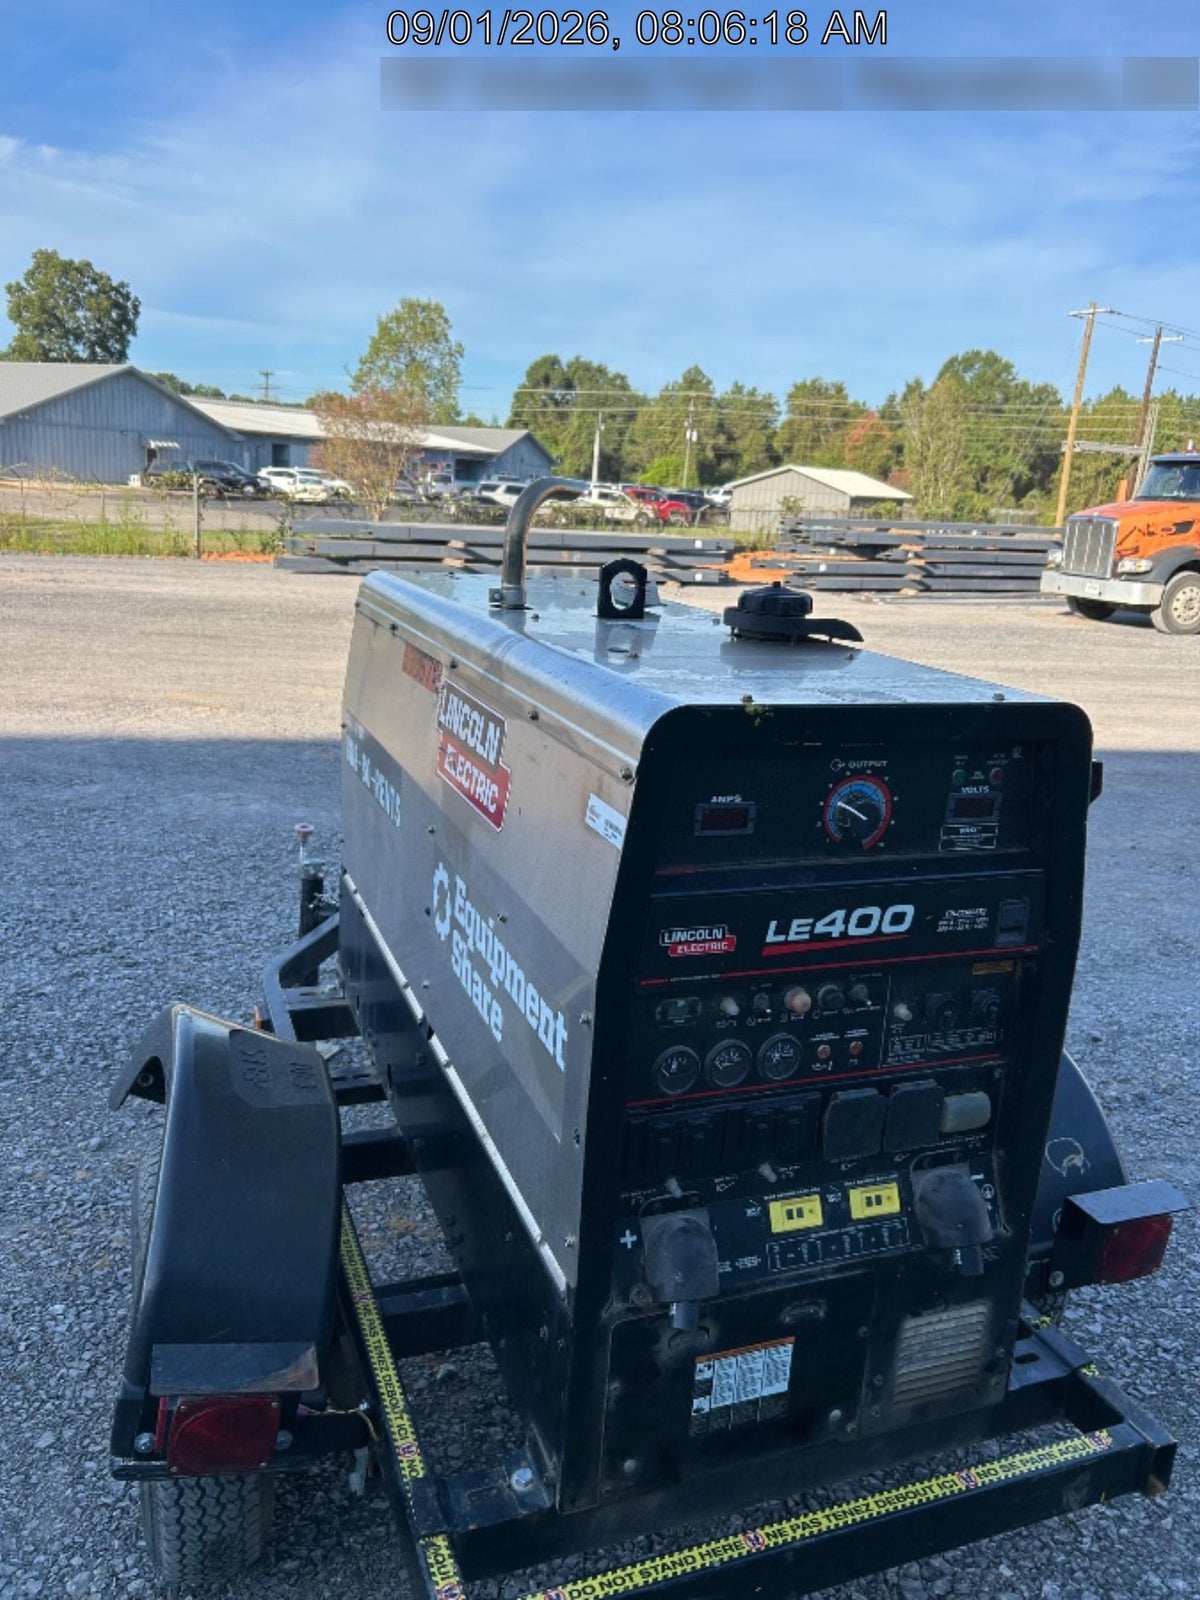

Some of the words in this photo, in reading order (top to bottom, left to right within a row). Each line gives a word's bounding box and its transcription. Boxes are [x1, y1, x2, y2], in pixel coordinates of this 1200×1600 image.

[439, 688, 500, 765] LINCOLN
[444, 743, 499, 814] ELECTRIC
[848, 760, 888, 769] OUTPUT
[961, 785, 989, 794] VOLTS
[664, 927, 723, 943] LINCOLN
[677, 941, 728, 954] ELECTRIC
[765, 904, 915, 943] LE400
[451, 929, 503, 1043] Share
[454, 874, 568, 1072] Equipment
[382, 1374, 404, 1421] DEBOUT
[396, 1424, 409, 1440] ICI
[568, 1585, 596, 1600] DO
[600, 1572, 637, 1591] NOT
[639, 1554, 696, 1579] STAND
[698, 1540, 746, 1562] HERE
[765, 1526, 790, 1542] NE
[789, 1517, 823, 1535] PAS
[824, 1501, 873, 1523] TENEZ
[875, 1482, 936, 1508] DEBOUT
[937, 1478, 959, 1491] ICI
[976, 1468, 999, 1480] NO
[1000, 1461, 1020, 1473] SE
